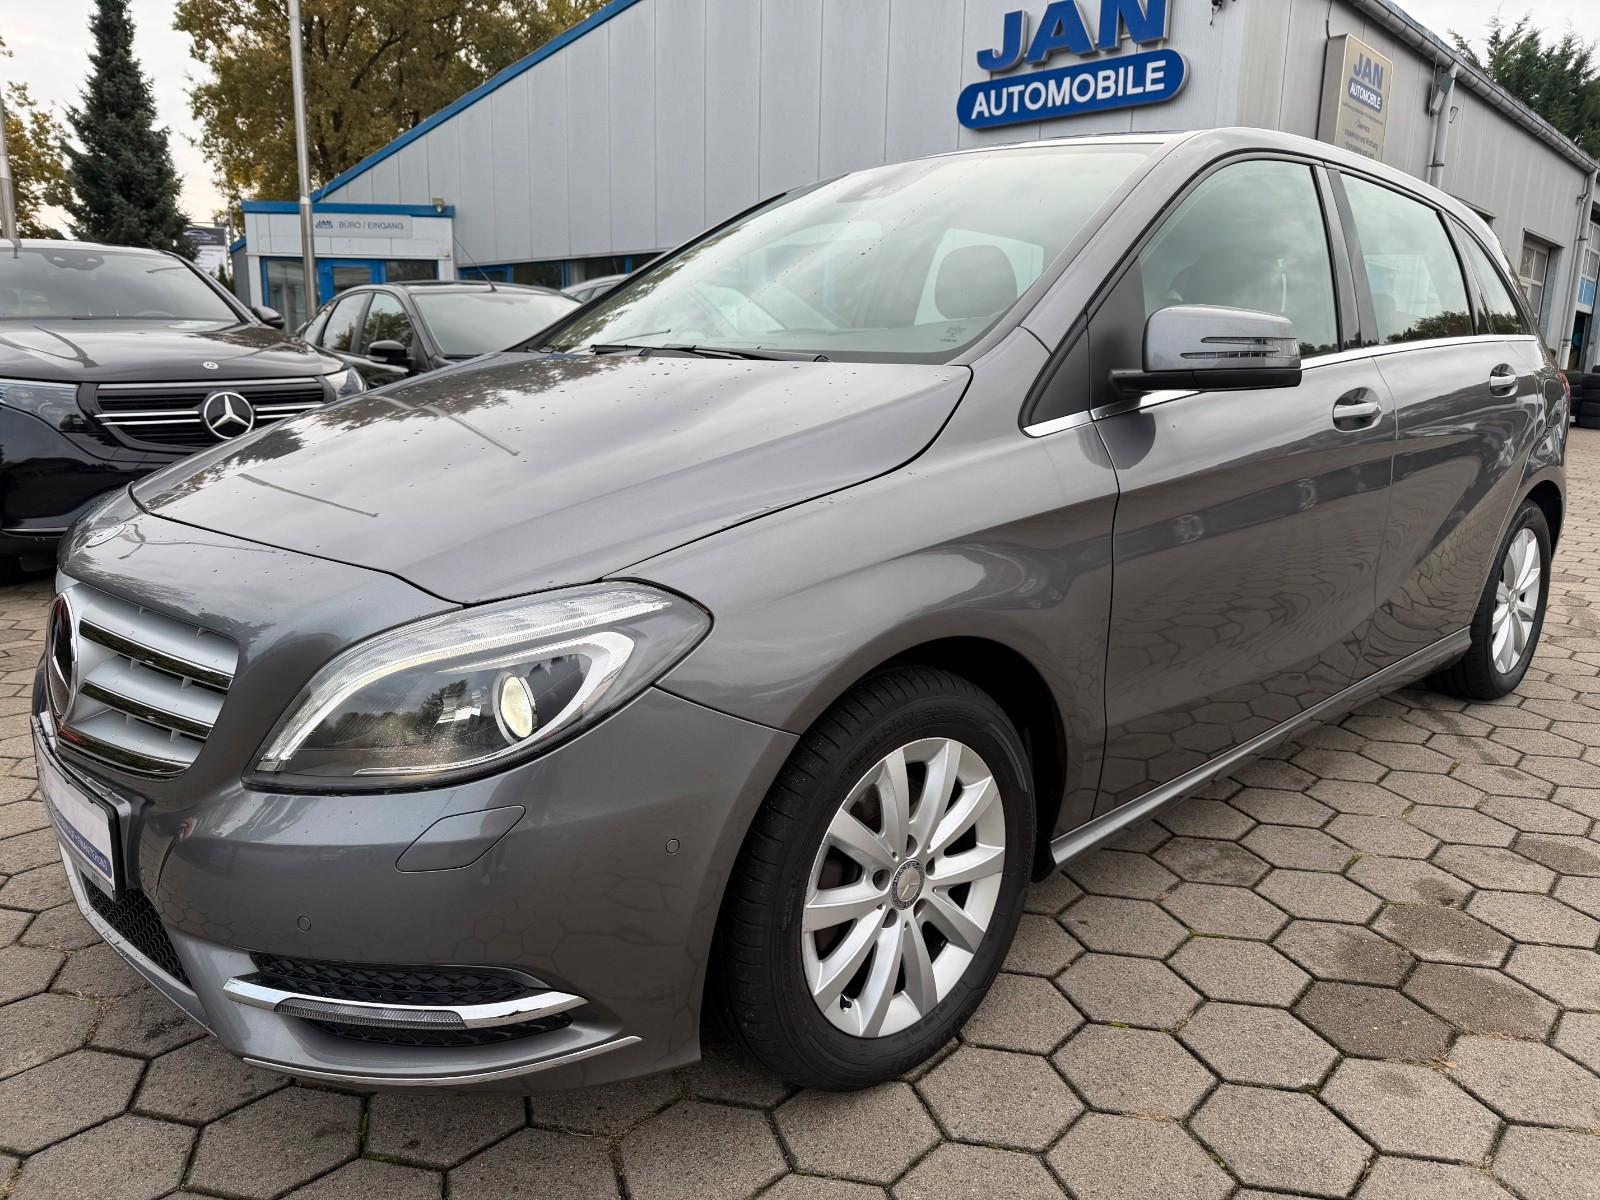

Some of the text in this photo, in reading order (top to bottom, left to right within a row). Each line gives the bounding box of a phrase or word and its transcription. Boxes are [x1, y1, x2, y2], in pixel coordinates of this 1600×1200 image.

[976, 0, 1168, 72] JAN
[970, 59, 1167, 120] AUTOMOBILE
[1352, 52, 1384, 90] JAN
[1350, 82, 1381, 110] AUTOMOBILE
[338, 220, 361, 229] BÜRO
[367, 221, 404, 230] EINGANG
